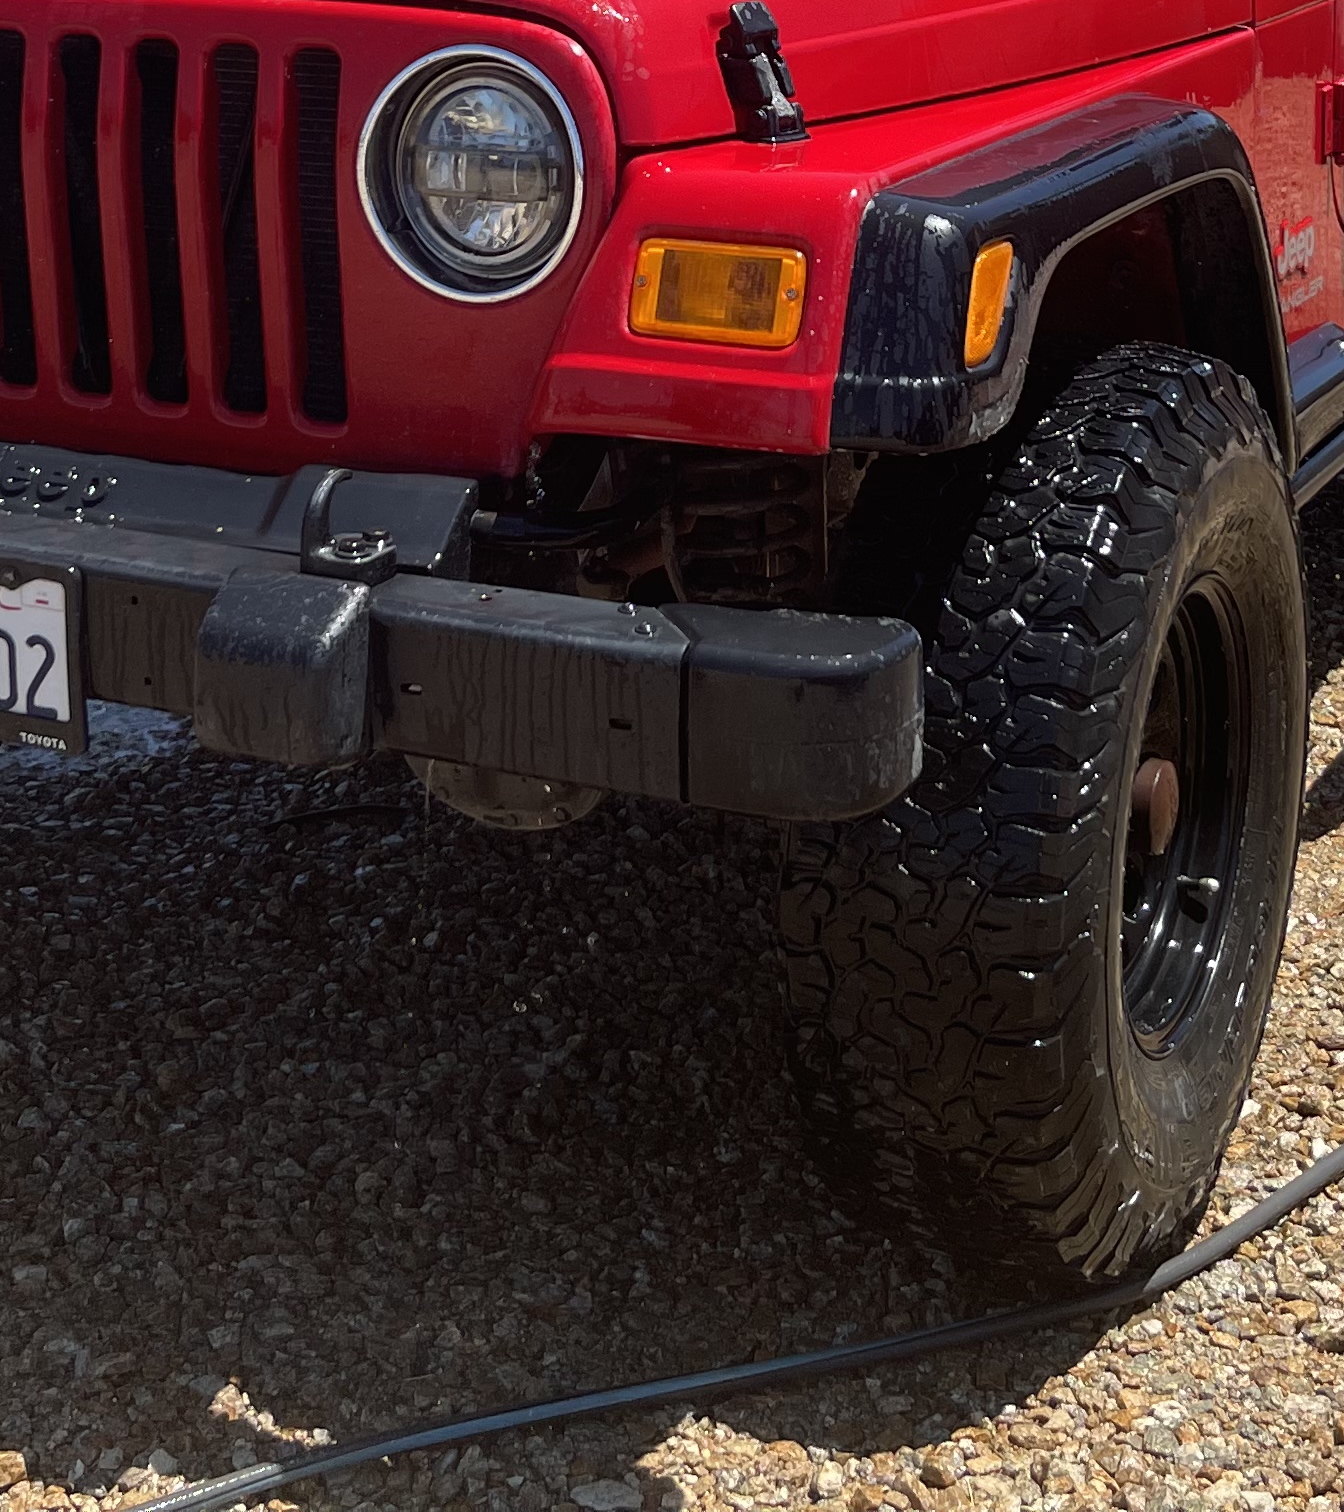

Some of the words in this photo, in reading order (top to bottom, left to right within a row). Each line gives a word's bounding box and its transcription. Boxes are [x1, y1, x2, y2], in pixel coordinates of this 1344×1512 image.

[1275, 223, 1315, 277] Jeep
[1281, 275, 1324, 313] ANGLER
[19, 731, 67, 751] TOYOTA
